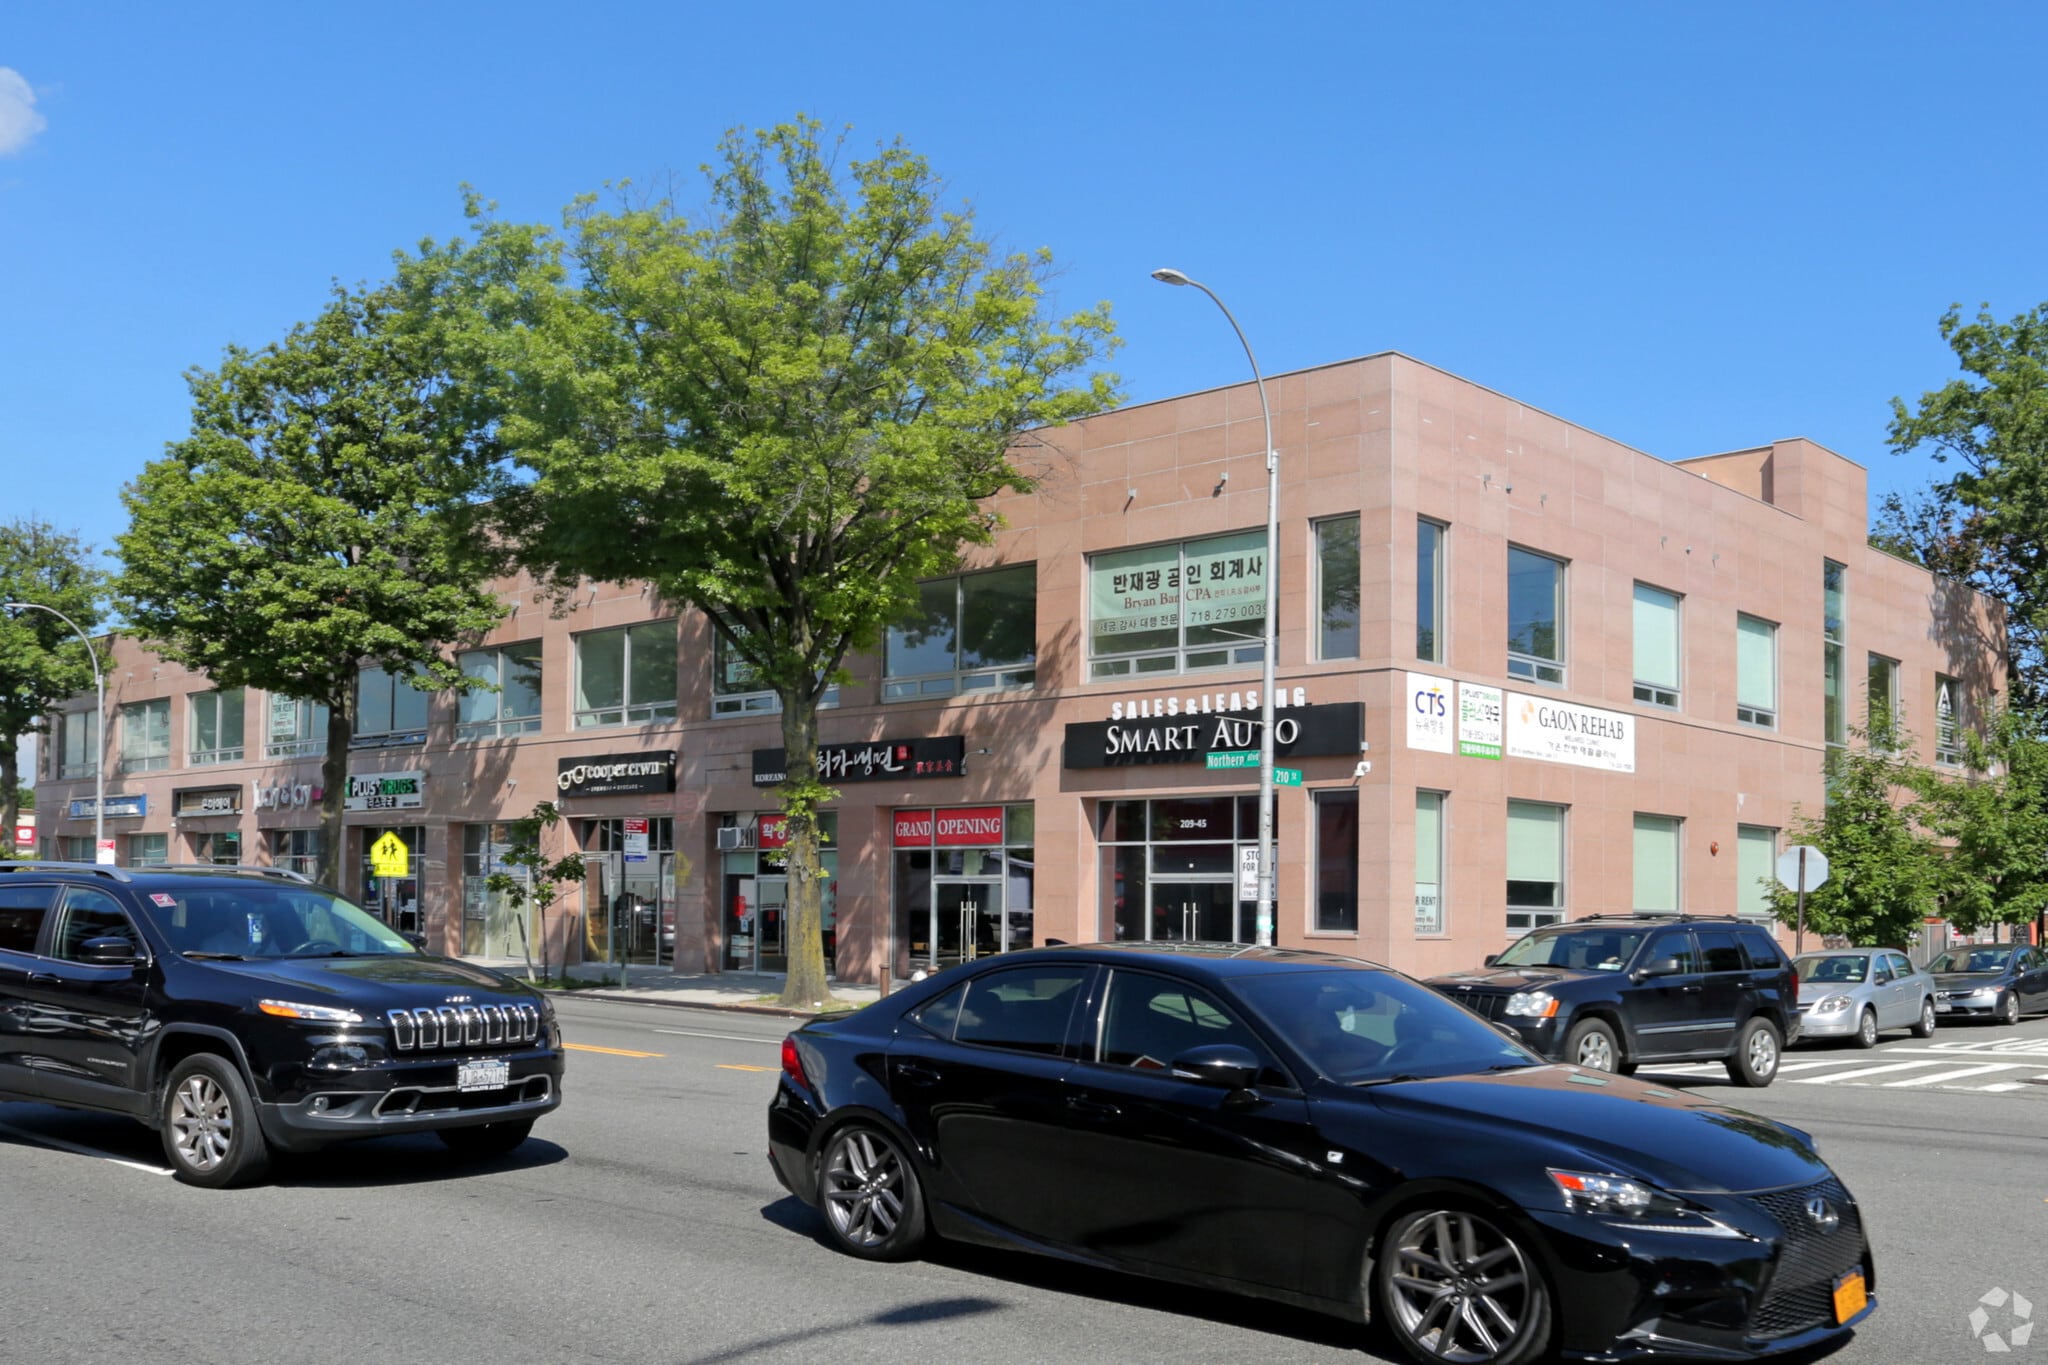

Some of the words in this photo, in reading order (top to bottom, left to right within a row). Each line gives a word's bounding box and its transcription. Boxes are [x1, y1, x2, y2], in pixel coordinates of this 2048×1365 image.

[1113, 570, 1161, 594] 반재광
[1168, 564, 1201, 587] 공인
[1210, 556, 1262, 580] 회계사
[1124, 597, 1156, 610] Bryan
[1186, 588, 1211, 601] CPA
[1112, 697, 1178, 720] SALES
[1186, 698, 1198, 715] &
[1202, 687, 1305, 713] LEASNG
[1415, 691, 1445, 717] CTS
[1539, 706, 1577, 732] GAON
[1581, 714, 1624, 740] REHAB
[1106, 725, 1199, 754] SMART
[1210, 718, 1298, 748] AUO
[1208, 753, 1245, 767] Northern
[587, 764, 627, 781] cooper
[1276, 770, 1289, 783] 210
[896, 821, 931, 836] GRAND
[938, 818, 1000, 835] OPENING
